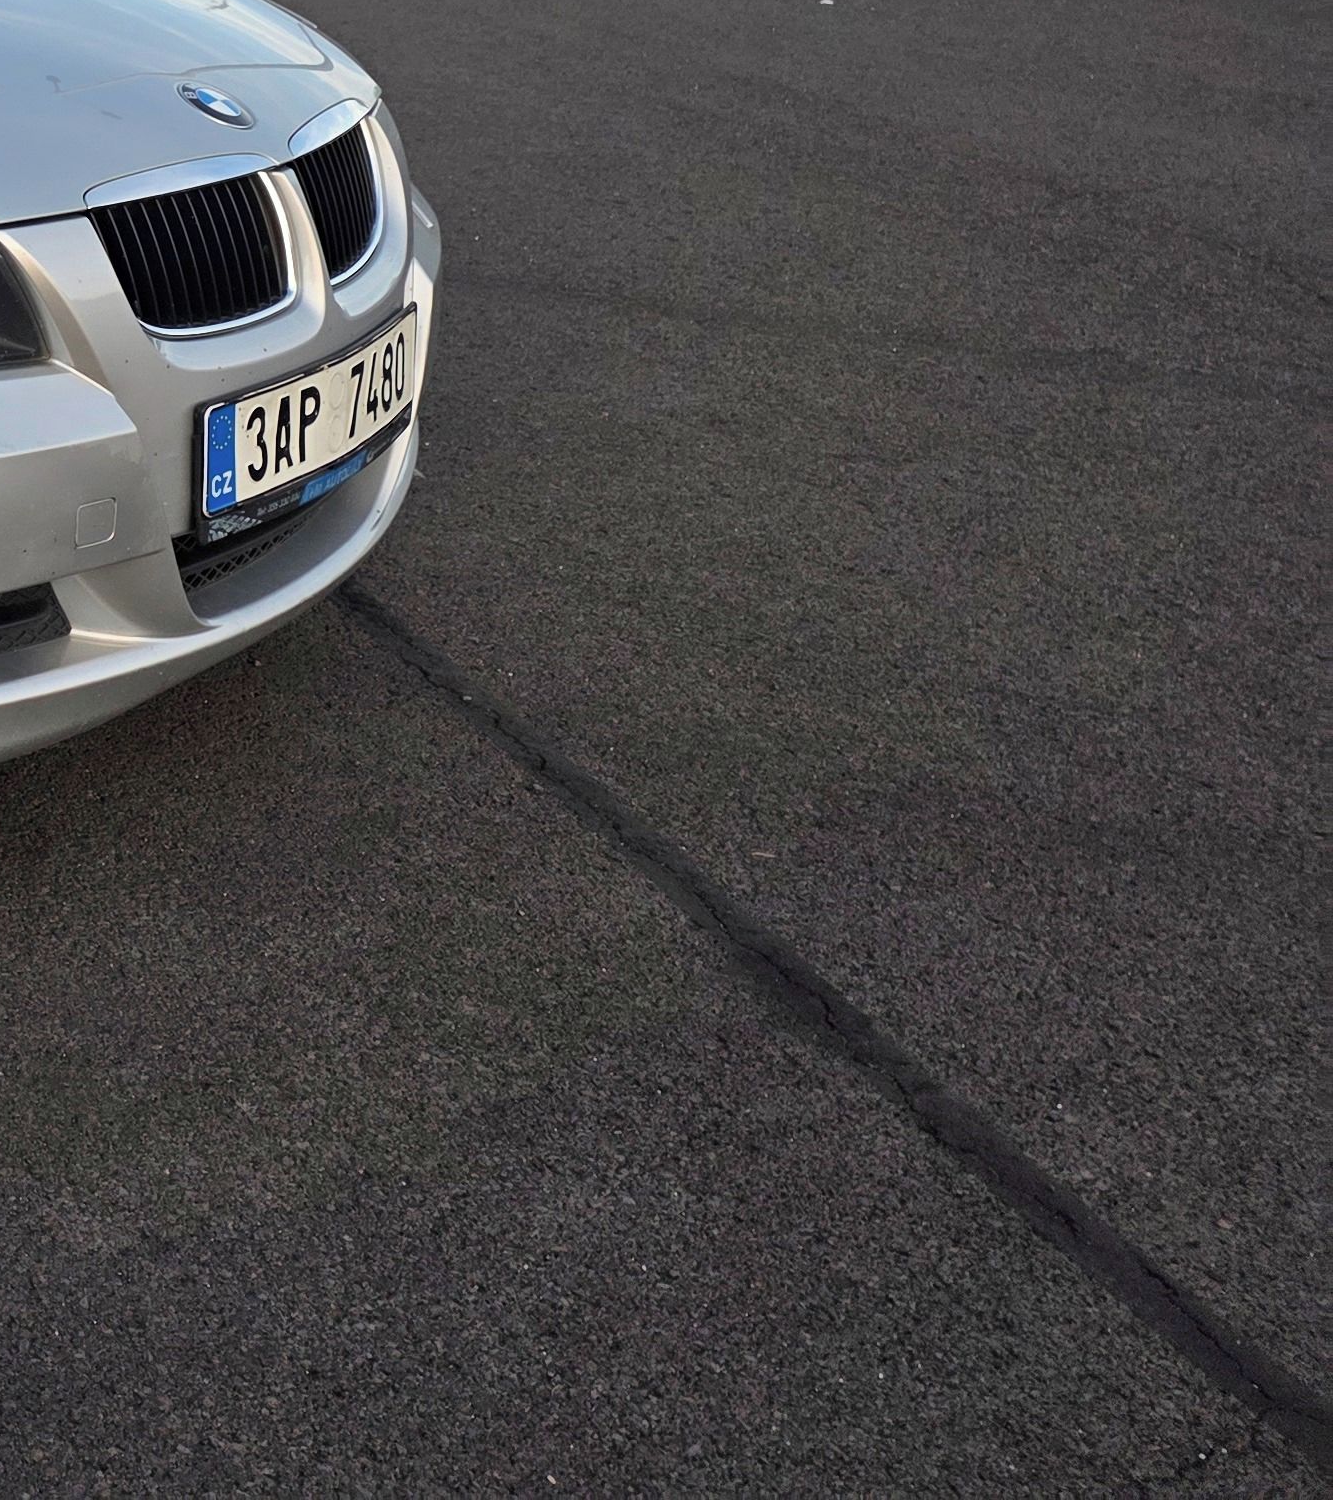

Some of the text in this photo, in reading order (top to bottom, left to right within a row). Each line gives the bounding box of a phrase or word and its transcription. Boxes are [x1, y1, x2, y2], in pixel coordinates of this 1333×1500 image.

[245, 331, 406, 483] 3AP 7480
[211, 470, 233, 498] CZ
